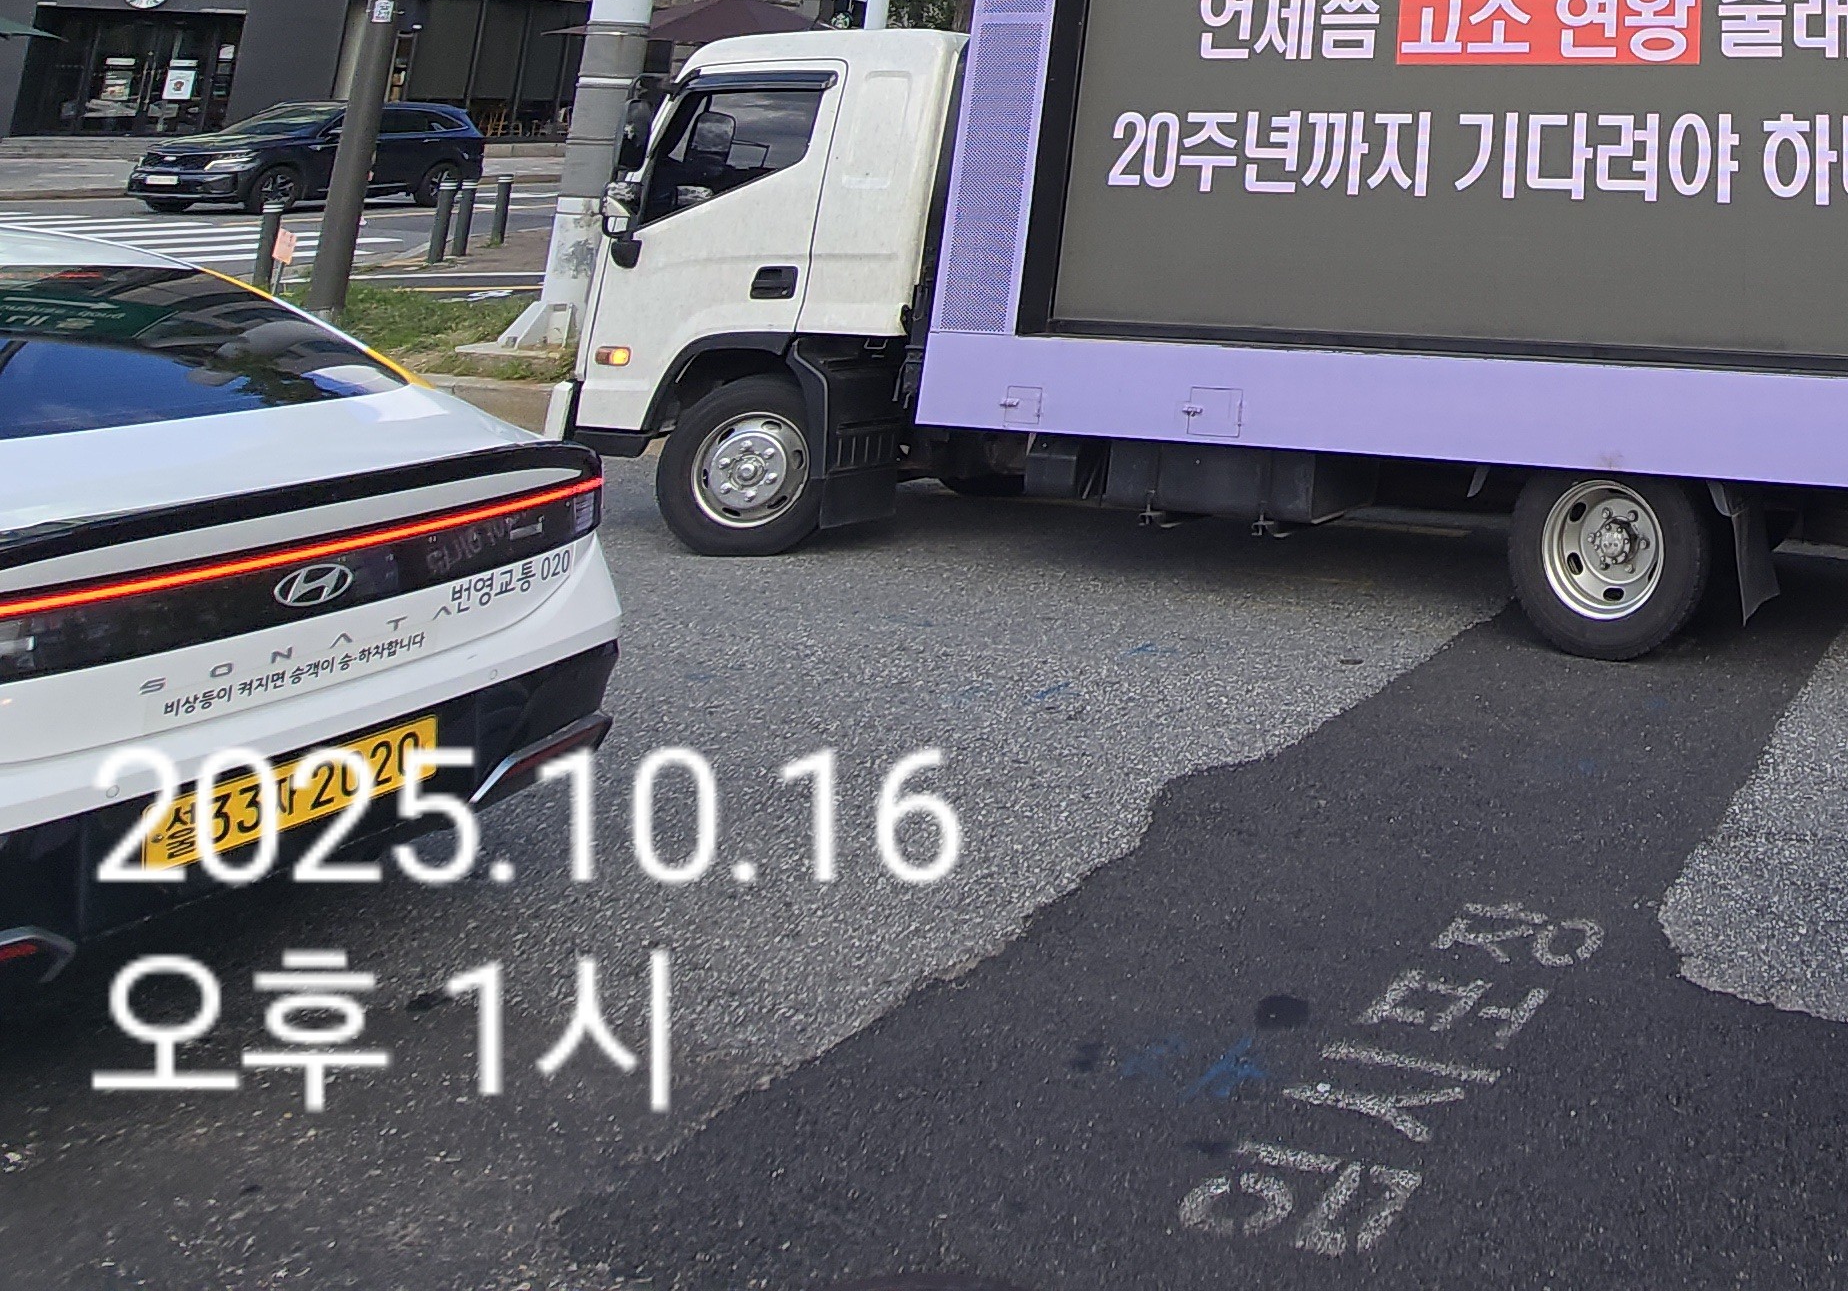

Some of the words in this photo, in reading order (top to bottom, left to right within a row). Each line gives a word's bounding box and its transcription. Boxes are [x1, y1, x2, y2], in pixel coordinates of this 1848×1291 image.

[1107, 109, 1432, 198] 20주년까지
[1455, 109, 1739, 206] 기다려야
[450, 560, 537, 614] 번영교통
[540, 549, 571, 581] 020
[139, 605, 452, 695] SONATA
[163, 684, 233, 717] 비상등이
[237, 668, 286, 697] 켜지면
[289, 656, 336, 685] 승객이
